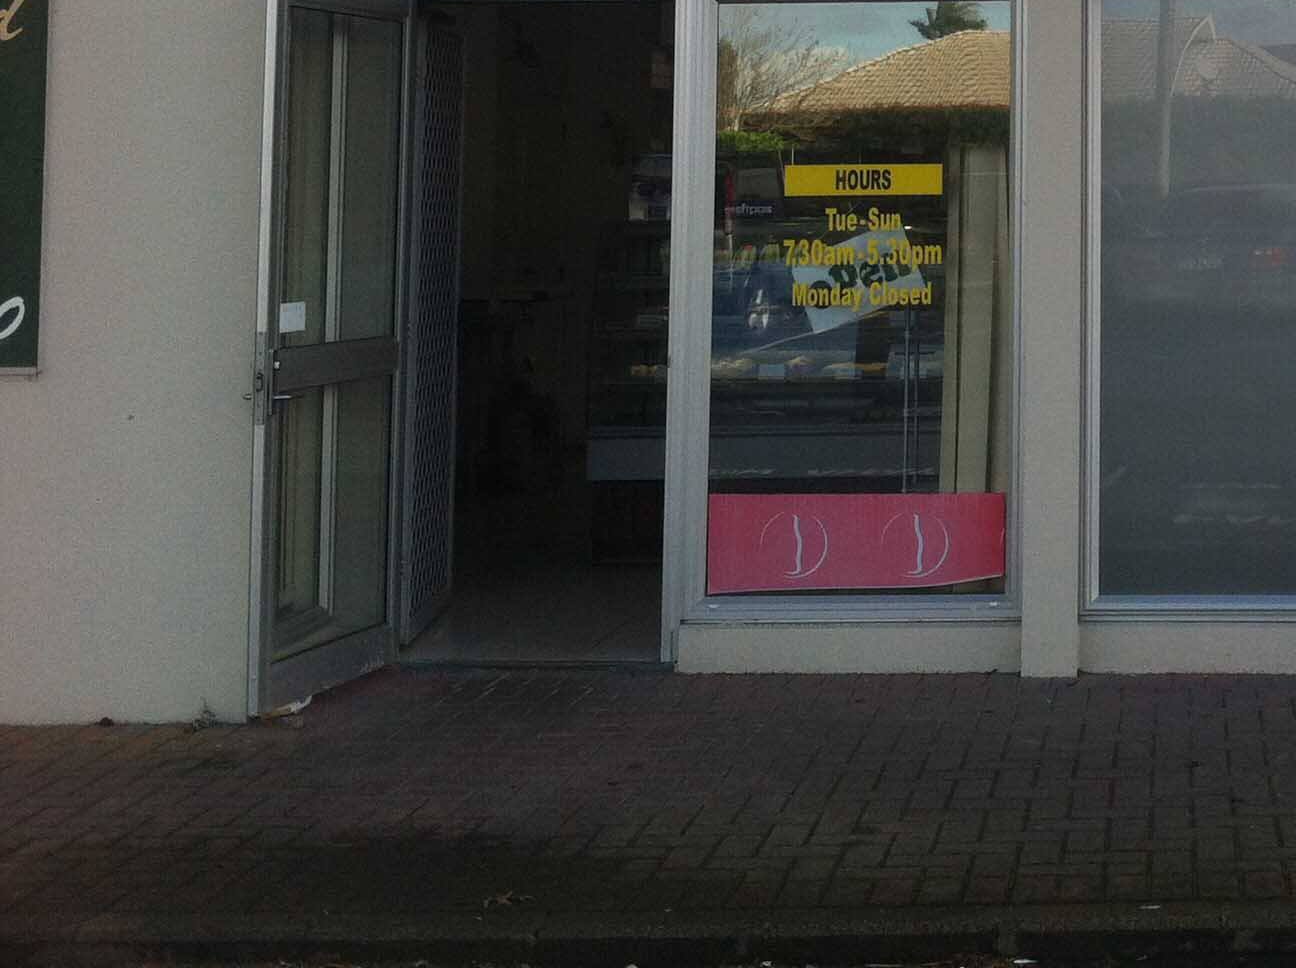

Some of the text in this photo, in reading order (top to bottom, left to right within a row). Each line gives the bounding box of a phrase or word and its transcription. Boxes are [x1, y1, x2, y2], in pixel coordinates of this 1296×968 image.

[835, 169, 892, 190] HOURS
[792, 281, 932, 312] Monday Closed
